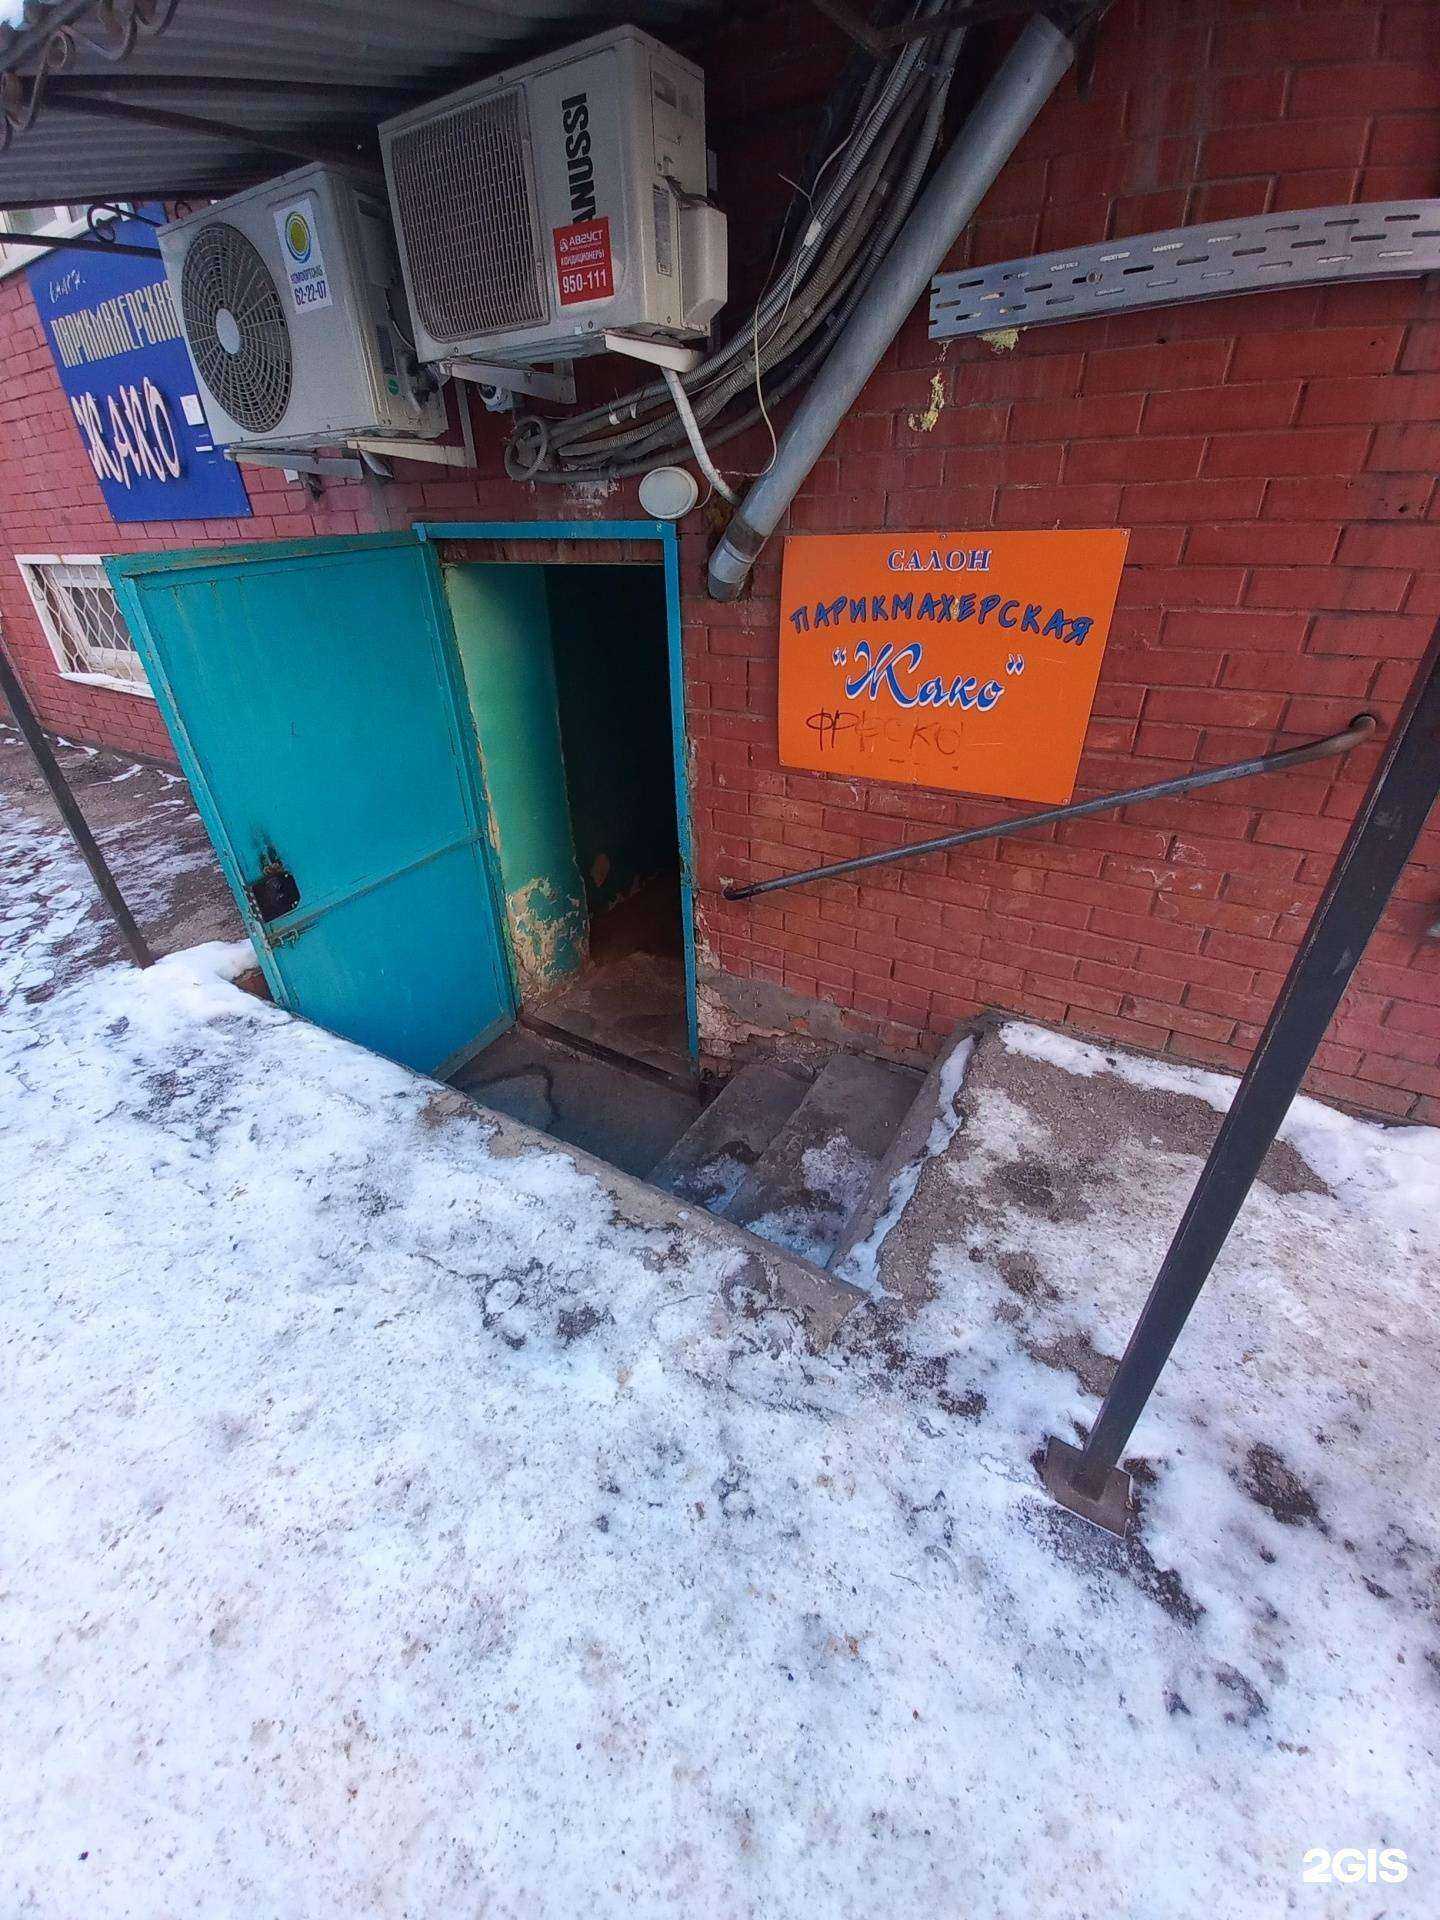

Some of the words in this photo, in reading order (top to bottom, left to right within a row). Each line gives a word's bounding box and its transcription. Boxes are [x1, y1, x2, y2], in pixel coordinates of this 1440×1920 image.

[561, 92, 597, 224] NUSSI
[294, 280, 327, 306] 62-22-07
[562, 268, 607, 294] 950-111
[70, 376, 181, 490] ЖАКО
[886, 548, 993, 572] САЛОН
[789, 591, 1094, 646] ПАРИКМАХЕРСКАЯ
